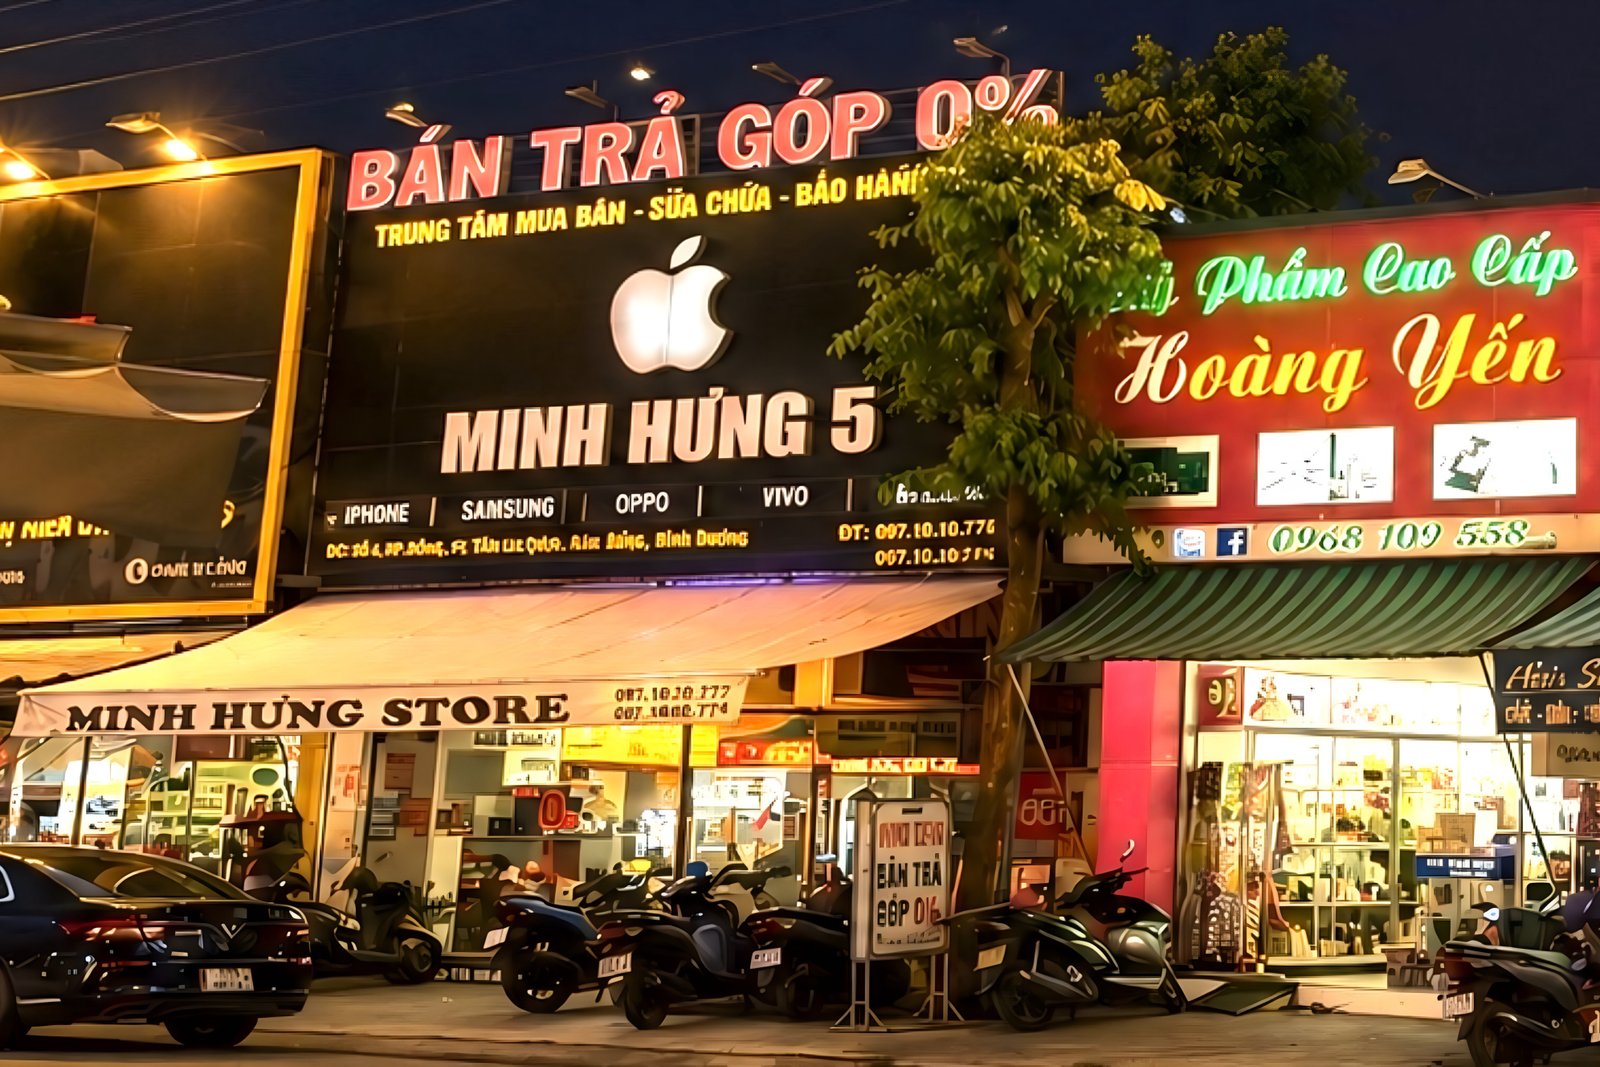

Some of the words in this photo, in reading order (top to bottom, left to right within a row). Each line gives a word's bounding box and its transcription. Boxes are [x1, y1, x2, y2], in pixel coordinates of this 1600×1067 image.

[347, 124, 507, 211] BÁN
[531, 90, 688, 192] TRẢ
[717, 76, 888, 170] GÓP
[915, 68, 1060, 151] 0%
[375, 218, 451, 248] TRUNG
[514, 207, 568, 235] MUA
[575, 197, 626, 228] BÁN
[795, 168, 848, 207] BẢO
[1196, 246, 1348, 315] Phẩm
[1363, 242, 1457, 295] Cao
[1471, 230, 1579, 296] Cấp
[1113, 330, 1369, 413] Hoàng
[1391, 312, 1562, 411] Yến
[440, 403, 611, 474] MINH
[628, 386, 810, 465] HƯNG
[830, 385, 877, 454] 5
[344, 502, 410, 525] IPHONE
[461, 496, 554, 521] SAMSUNG
[615, 491, 670, 514] OPPO
[763, 485, 809, 507] VIVO
[1268, 523, 1364, 554] 0968
[1454, 518, 1531, 549] 558
[66, 703, 197, 731] MINH
[210, 695, 365, 731] HƯNG
[382, 693, 571, 727] STORE
